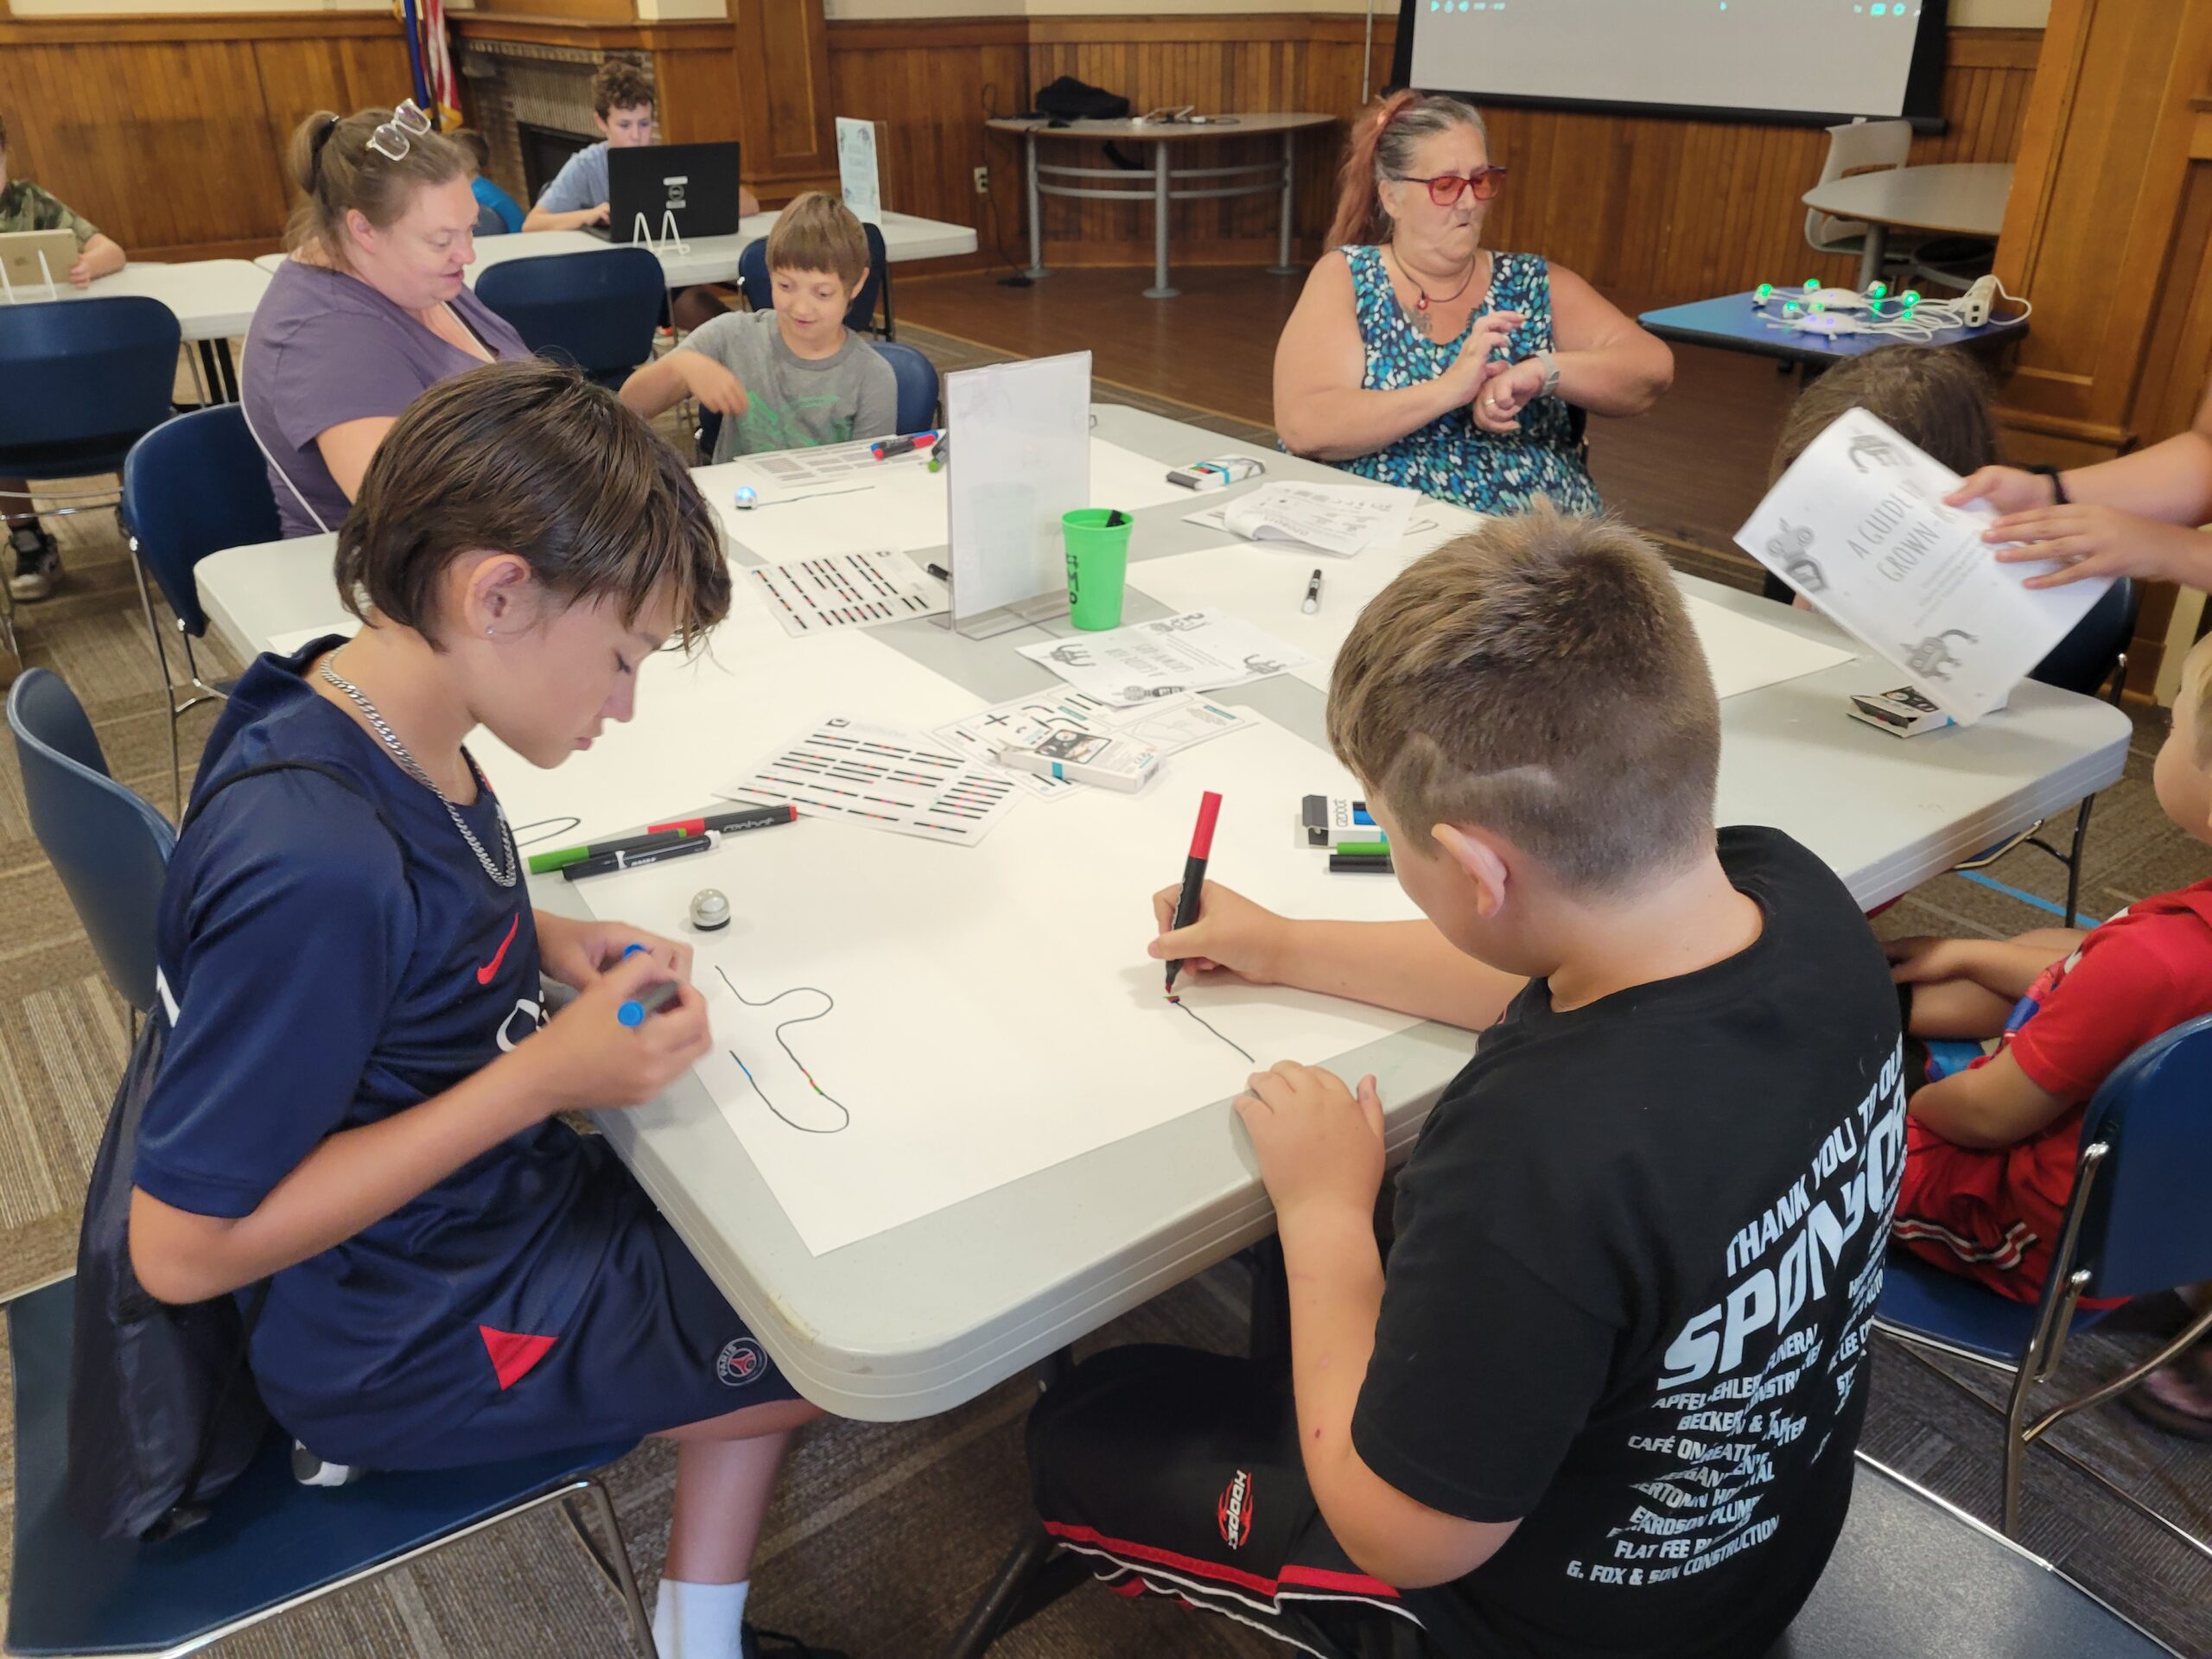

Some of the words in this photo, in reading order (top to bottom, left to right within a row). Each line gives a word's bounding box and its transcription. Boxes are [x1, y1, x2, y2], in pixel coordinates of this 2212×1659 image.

[1847, 539, 1872, 560] A
[1727, 1173, 1811, 1278] THANK
[1812, 1116, 1858, 1191] YOU
[1858, 1083, 1878, 1136] TO
[1840, 1332, 1859, 1362] LEE
[1628, 1435, 1676, 1453] CAFÉ
[1226, 1469, 1248, 1550] HOOPS
[1567, 1560, 1584, 1580] G.
[1590, 1564, 1628, 1585] FOX
[1629, 1568, 1643, 1586] &
[1647, 1565, 1683, 1585] SON
[1682, 1515, 1780, 1577] CONSTRUCTION
[1614, 1540, 1659, 1560] FLAT
[1659, 1539, 1691, 1559] FEE
